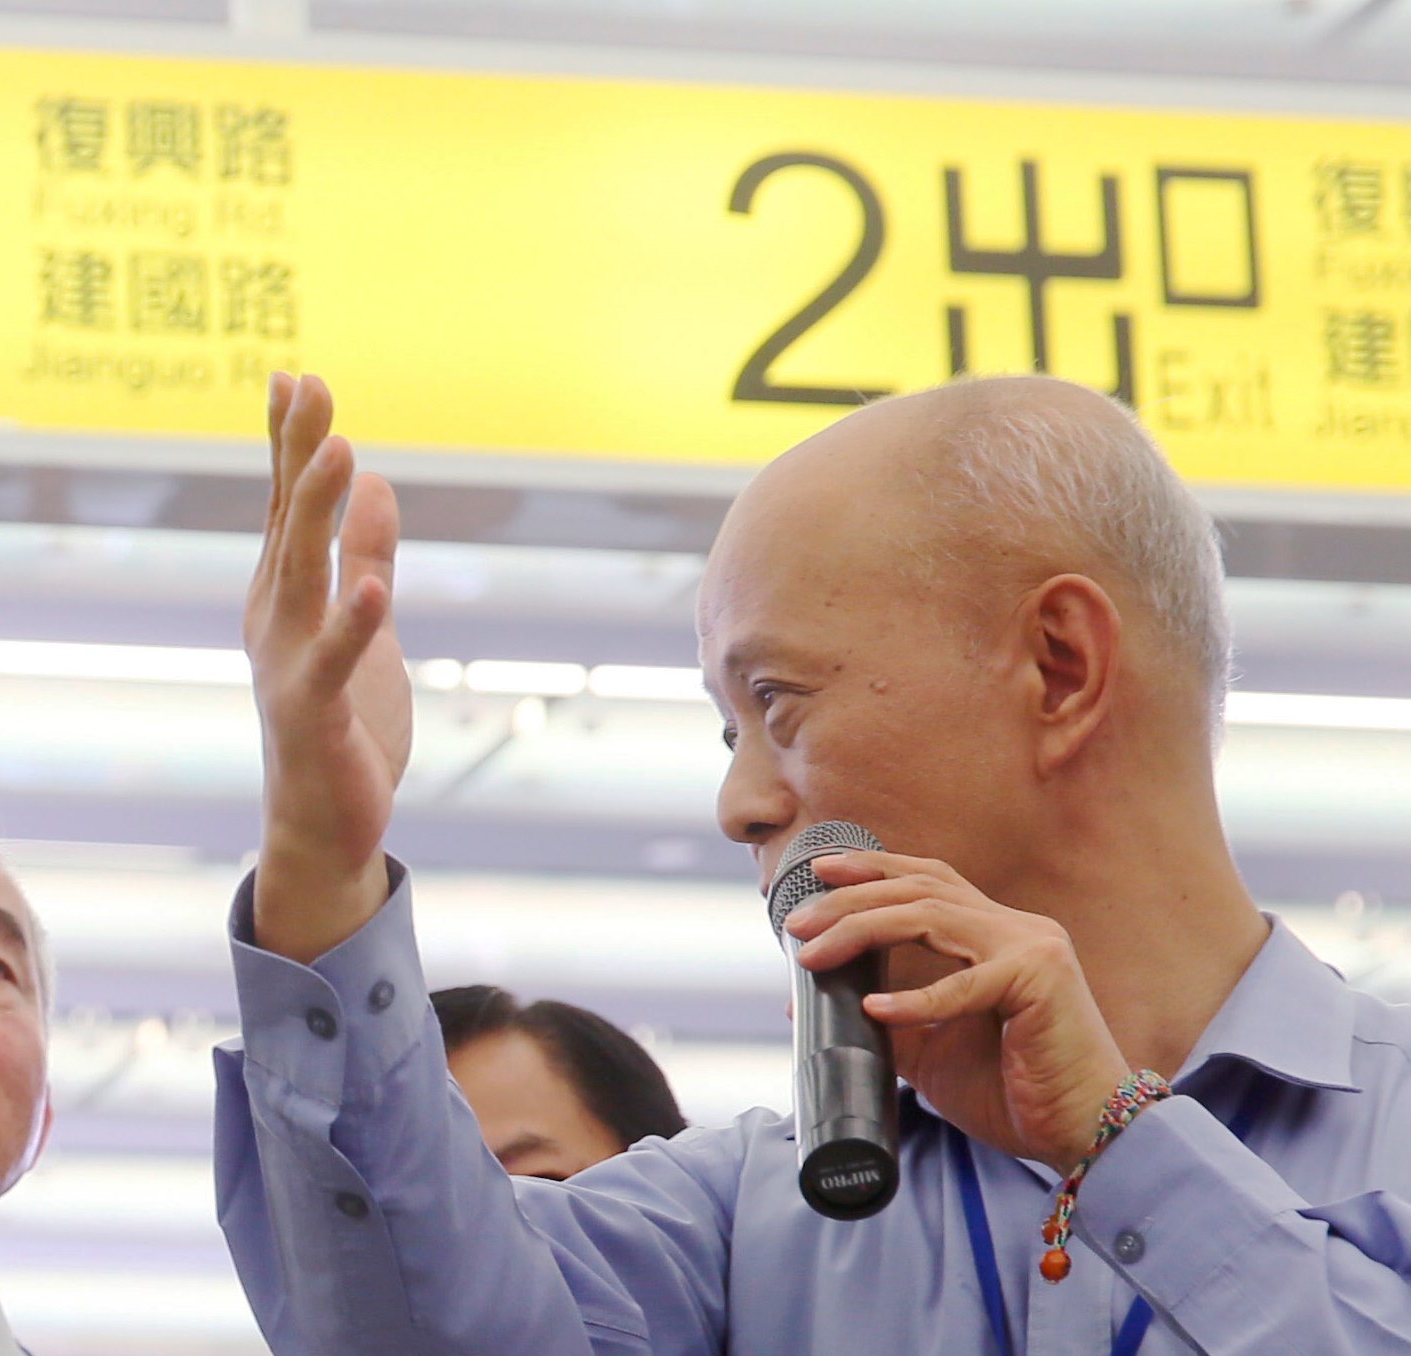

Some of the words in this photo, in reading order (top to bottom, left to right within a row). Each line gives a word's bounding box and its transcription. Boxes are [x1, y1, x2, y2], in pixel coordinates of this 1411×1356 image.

[35, 97, 295, 187] 復興路
[1313, 157, 1411, 234] 復
[39, 249, 299, 341] 建國路
[1323, 308, 1411, 383] 建
[1156, 348, 1273, 432] Exit
